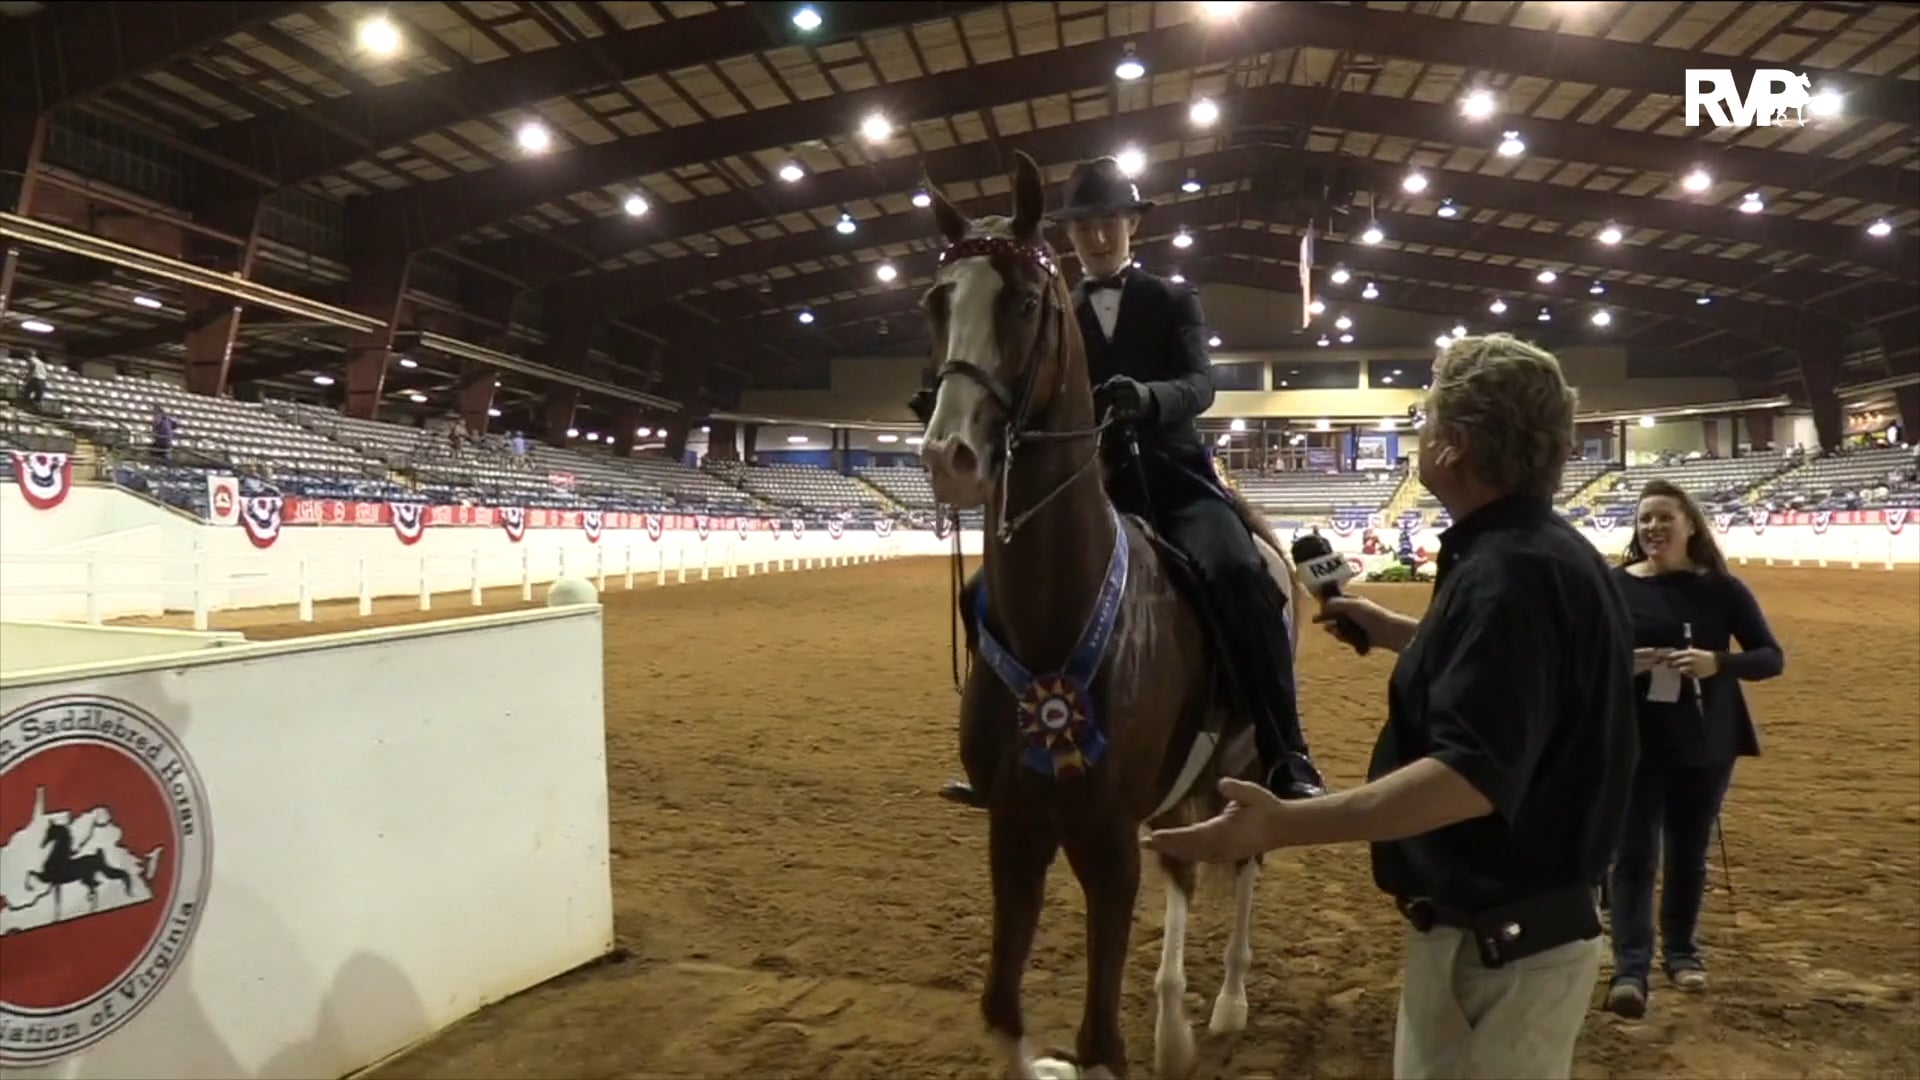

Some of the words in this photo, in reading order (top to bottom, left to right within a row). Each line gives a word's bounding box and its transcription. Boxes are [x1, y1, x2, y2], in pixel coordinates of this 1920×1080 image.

[21, 708, 164, 761] Saddlebred
[161, 758, 194, 837] Horse
[90, 998, 116, 1027] of
[119, 902, 194, 999] Virginia
